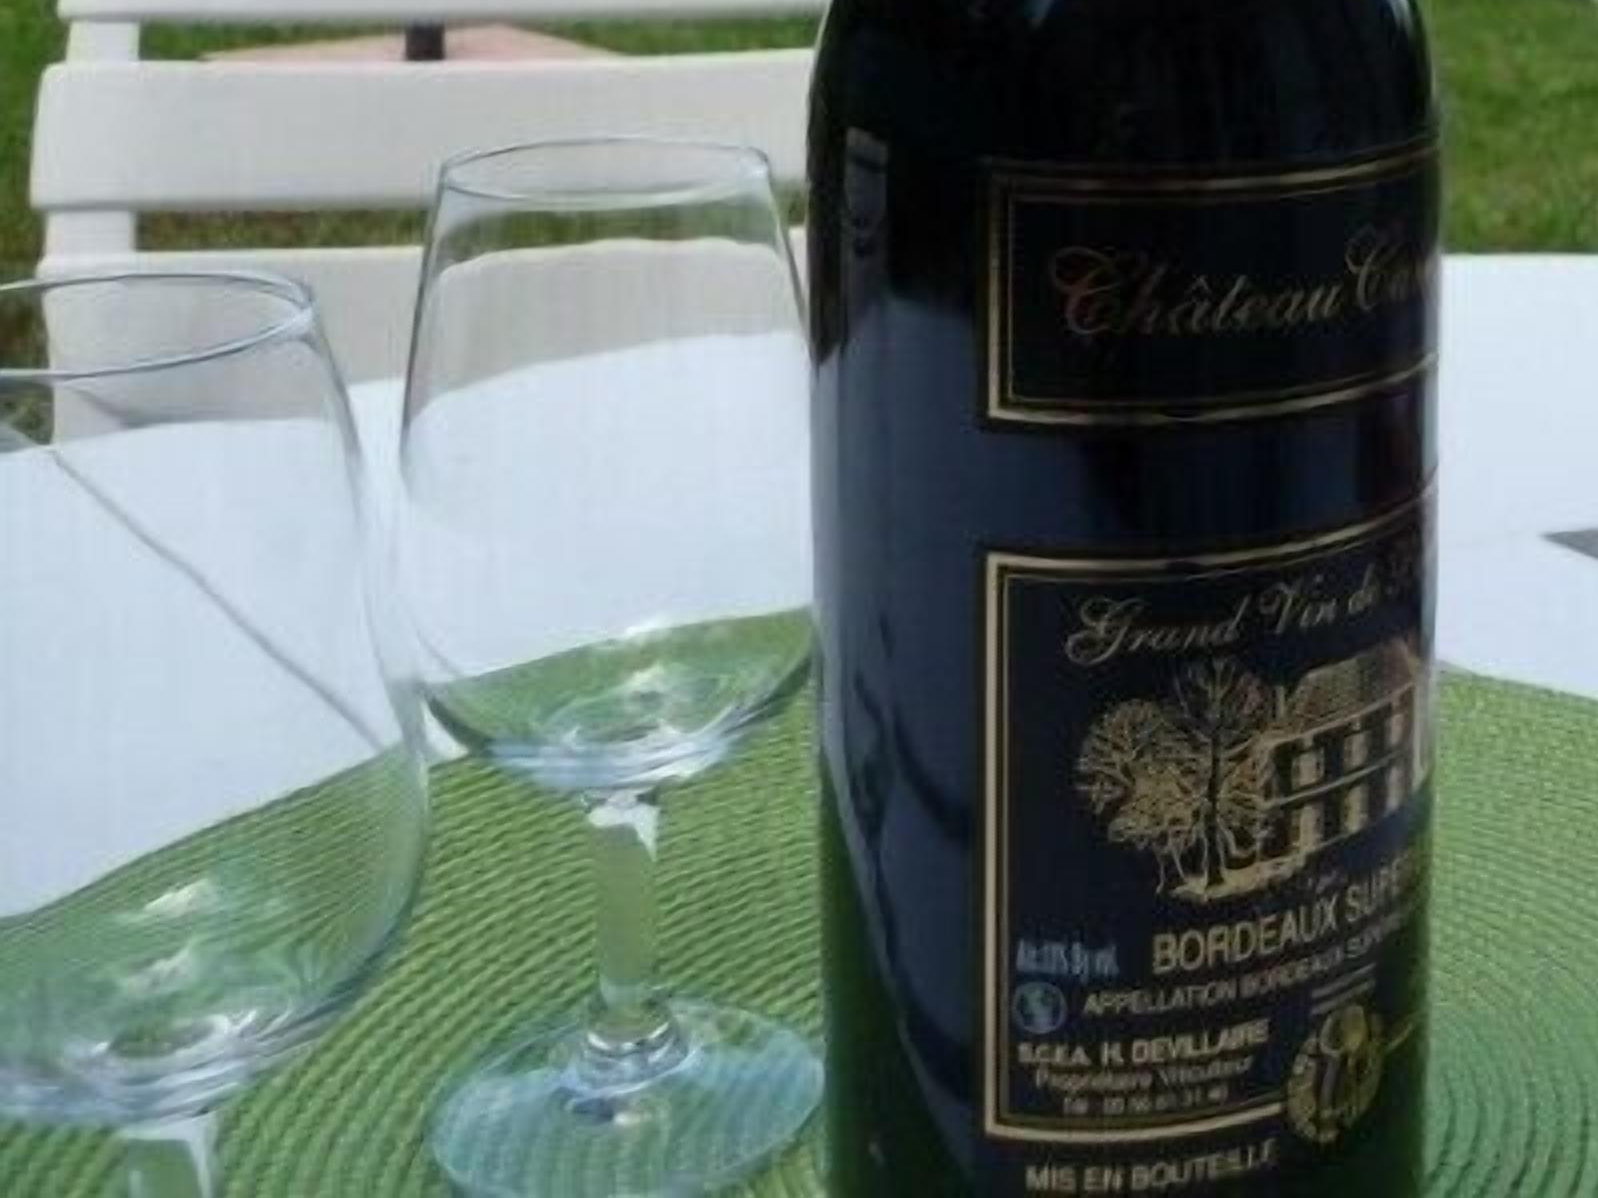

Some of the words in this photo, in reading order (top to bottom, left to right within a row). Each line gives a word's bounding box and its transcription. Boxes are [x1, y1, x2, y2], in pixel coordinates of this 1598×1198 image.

[1065, 595, 1248, 666] Grand
[1258, 576, 1337, 635] Vin
[1151, 900, 1338, 975] BORDEAUX
[1025, 1162, 1077, 1193] MIS
